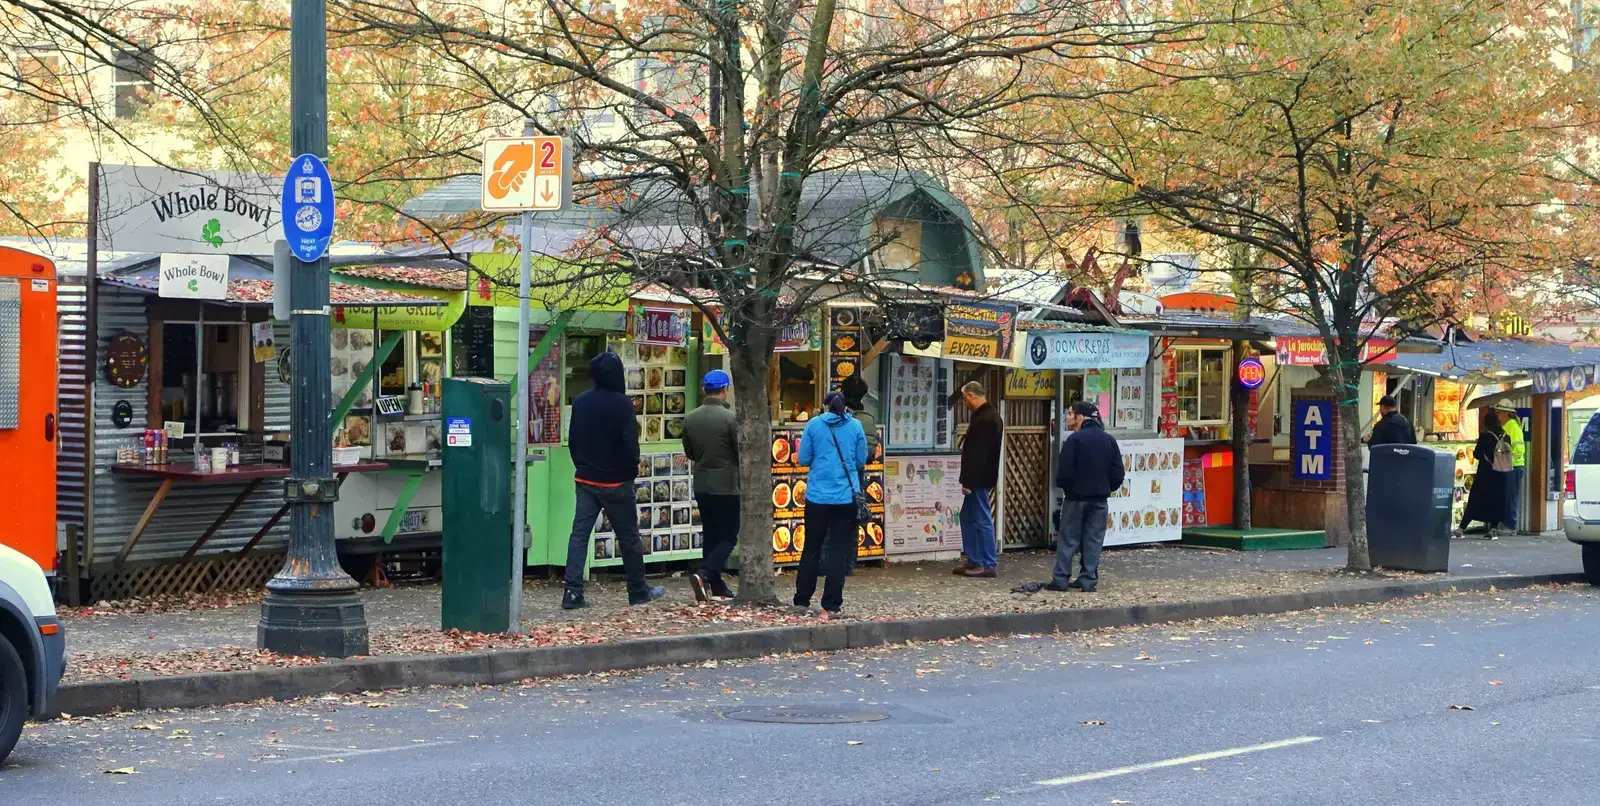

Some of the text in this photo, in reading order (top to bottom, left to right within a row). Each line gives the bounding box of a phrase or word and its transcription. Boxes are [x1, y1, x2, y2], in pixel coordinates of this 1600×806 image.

[541, 141, 555, 168] 2
[151, 187, 272, 228] Whole Bowl
[164, 265, 225, 284] Whole Bowl
[651, 314, 669, 338] Kee
[949, 341, 991, 357] EXPRESS
[1288, 340, 1296, 352] La
[1004, 368, 1028, 391] Thai
[1239, 366, 1261, 380] OPEN
[380, 398, 402, 412] OPEN
[1301, 405, 1324, 475] ATM
